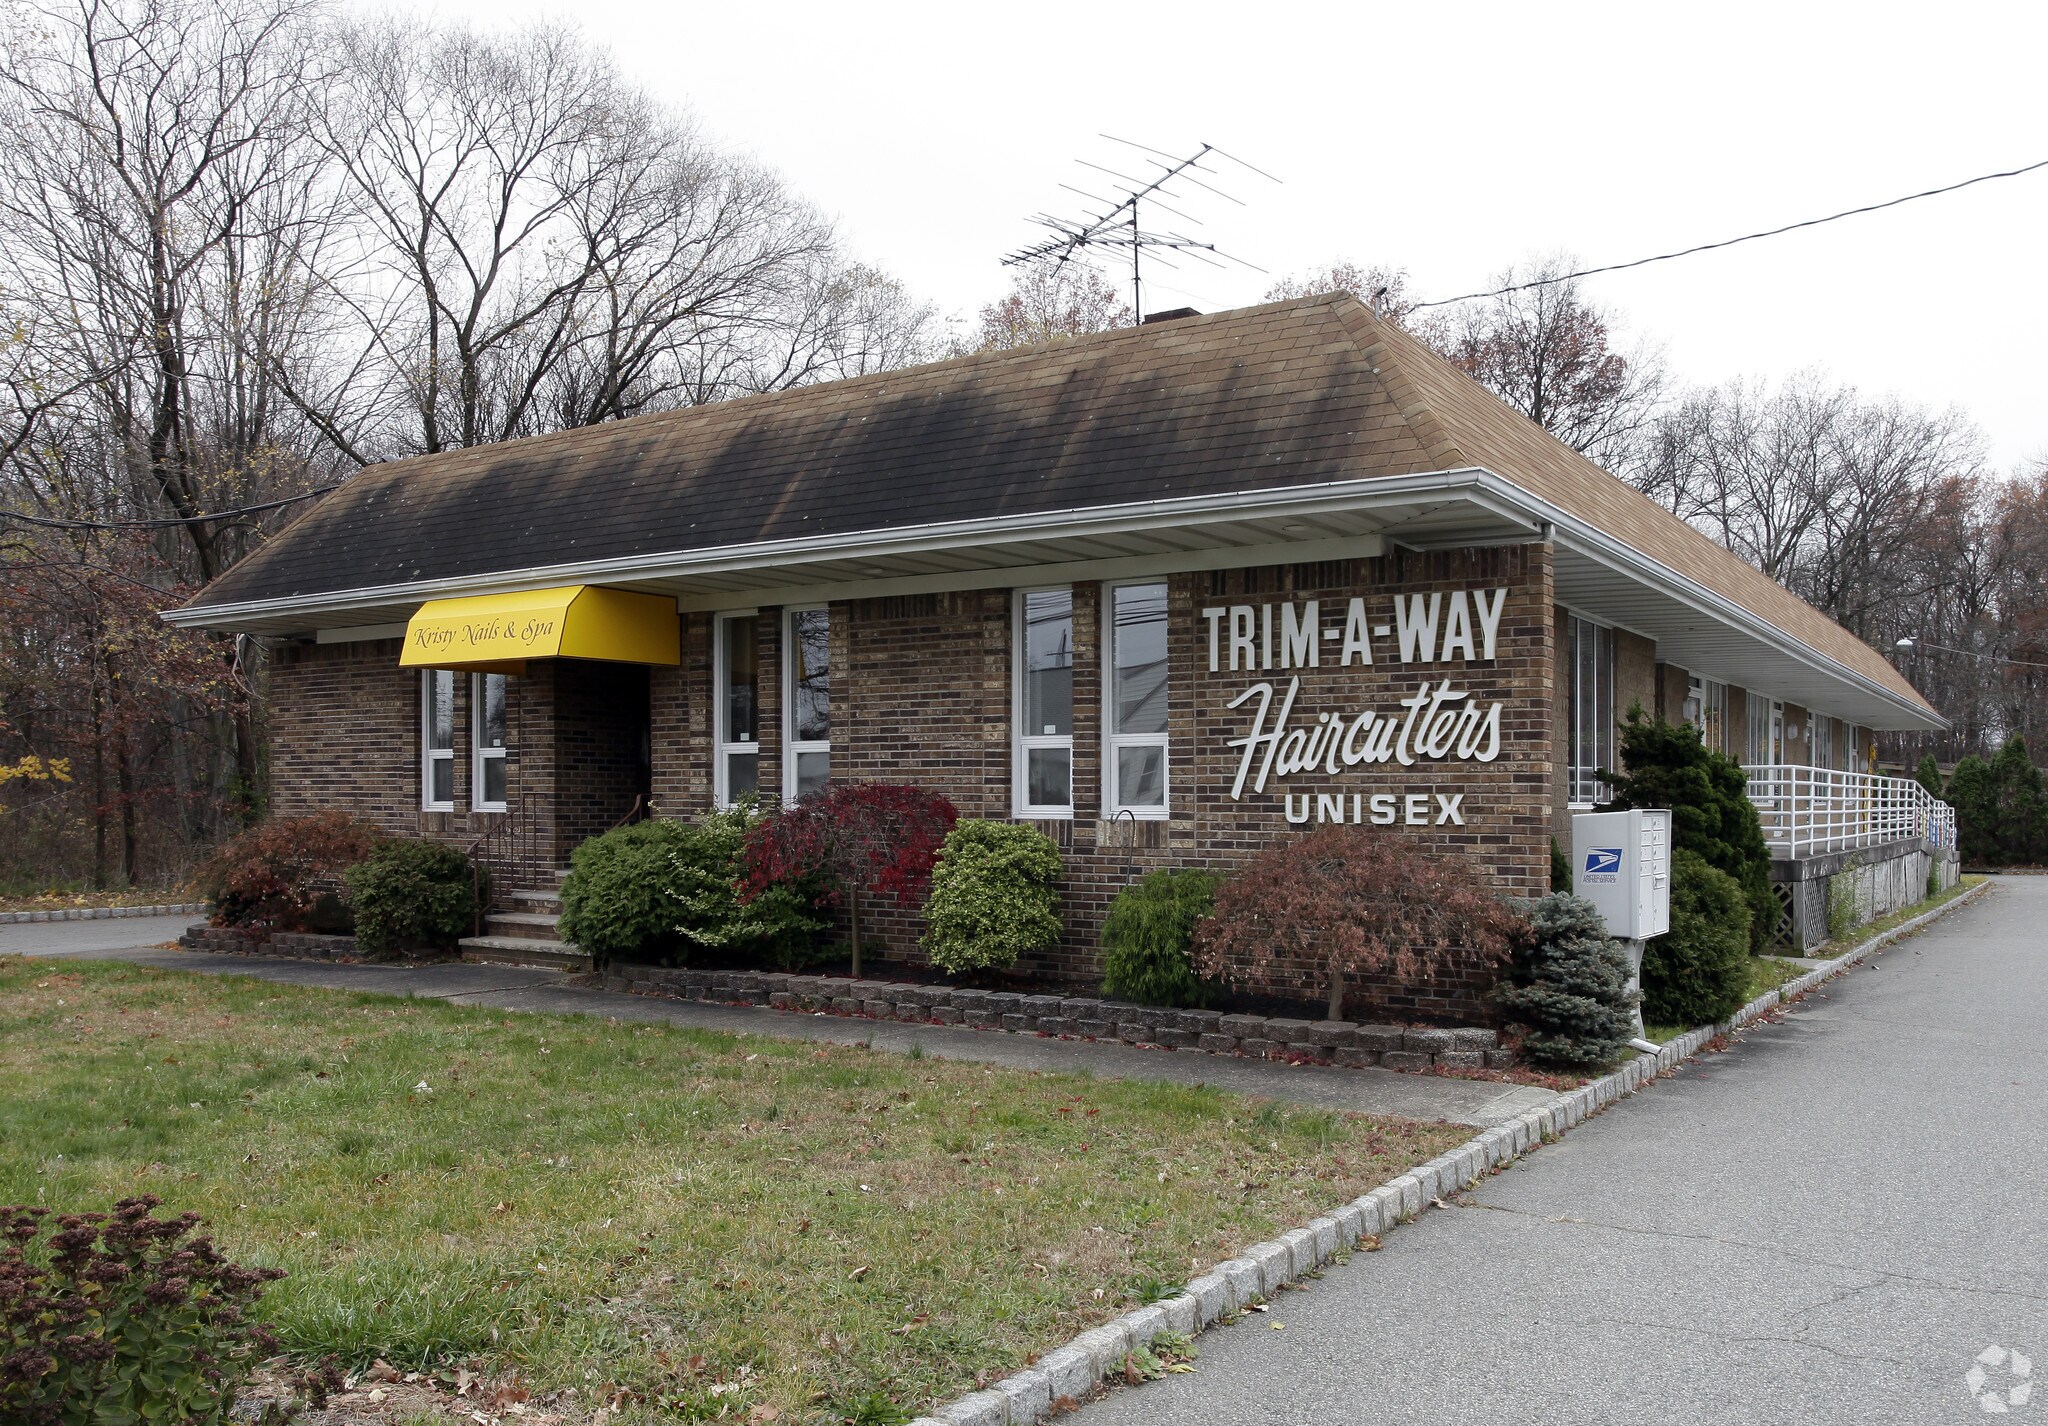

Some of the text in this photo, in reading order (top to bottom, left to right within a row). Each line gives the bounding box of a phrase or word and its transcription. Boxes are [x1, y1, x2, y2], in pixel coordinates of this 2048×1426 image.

[414, 618, 553, 651] Kristy Nails & Spa
[1202, 588, 1508, 672] TRIM-A-WAY
[1226, 674, 1504, 801] Haircutters
[1284, 793, 1466, 826] UNISEX
